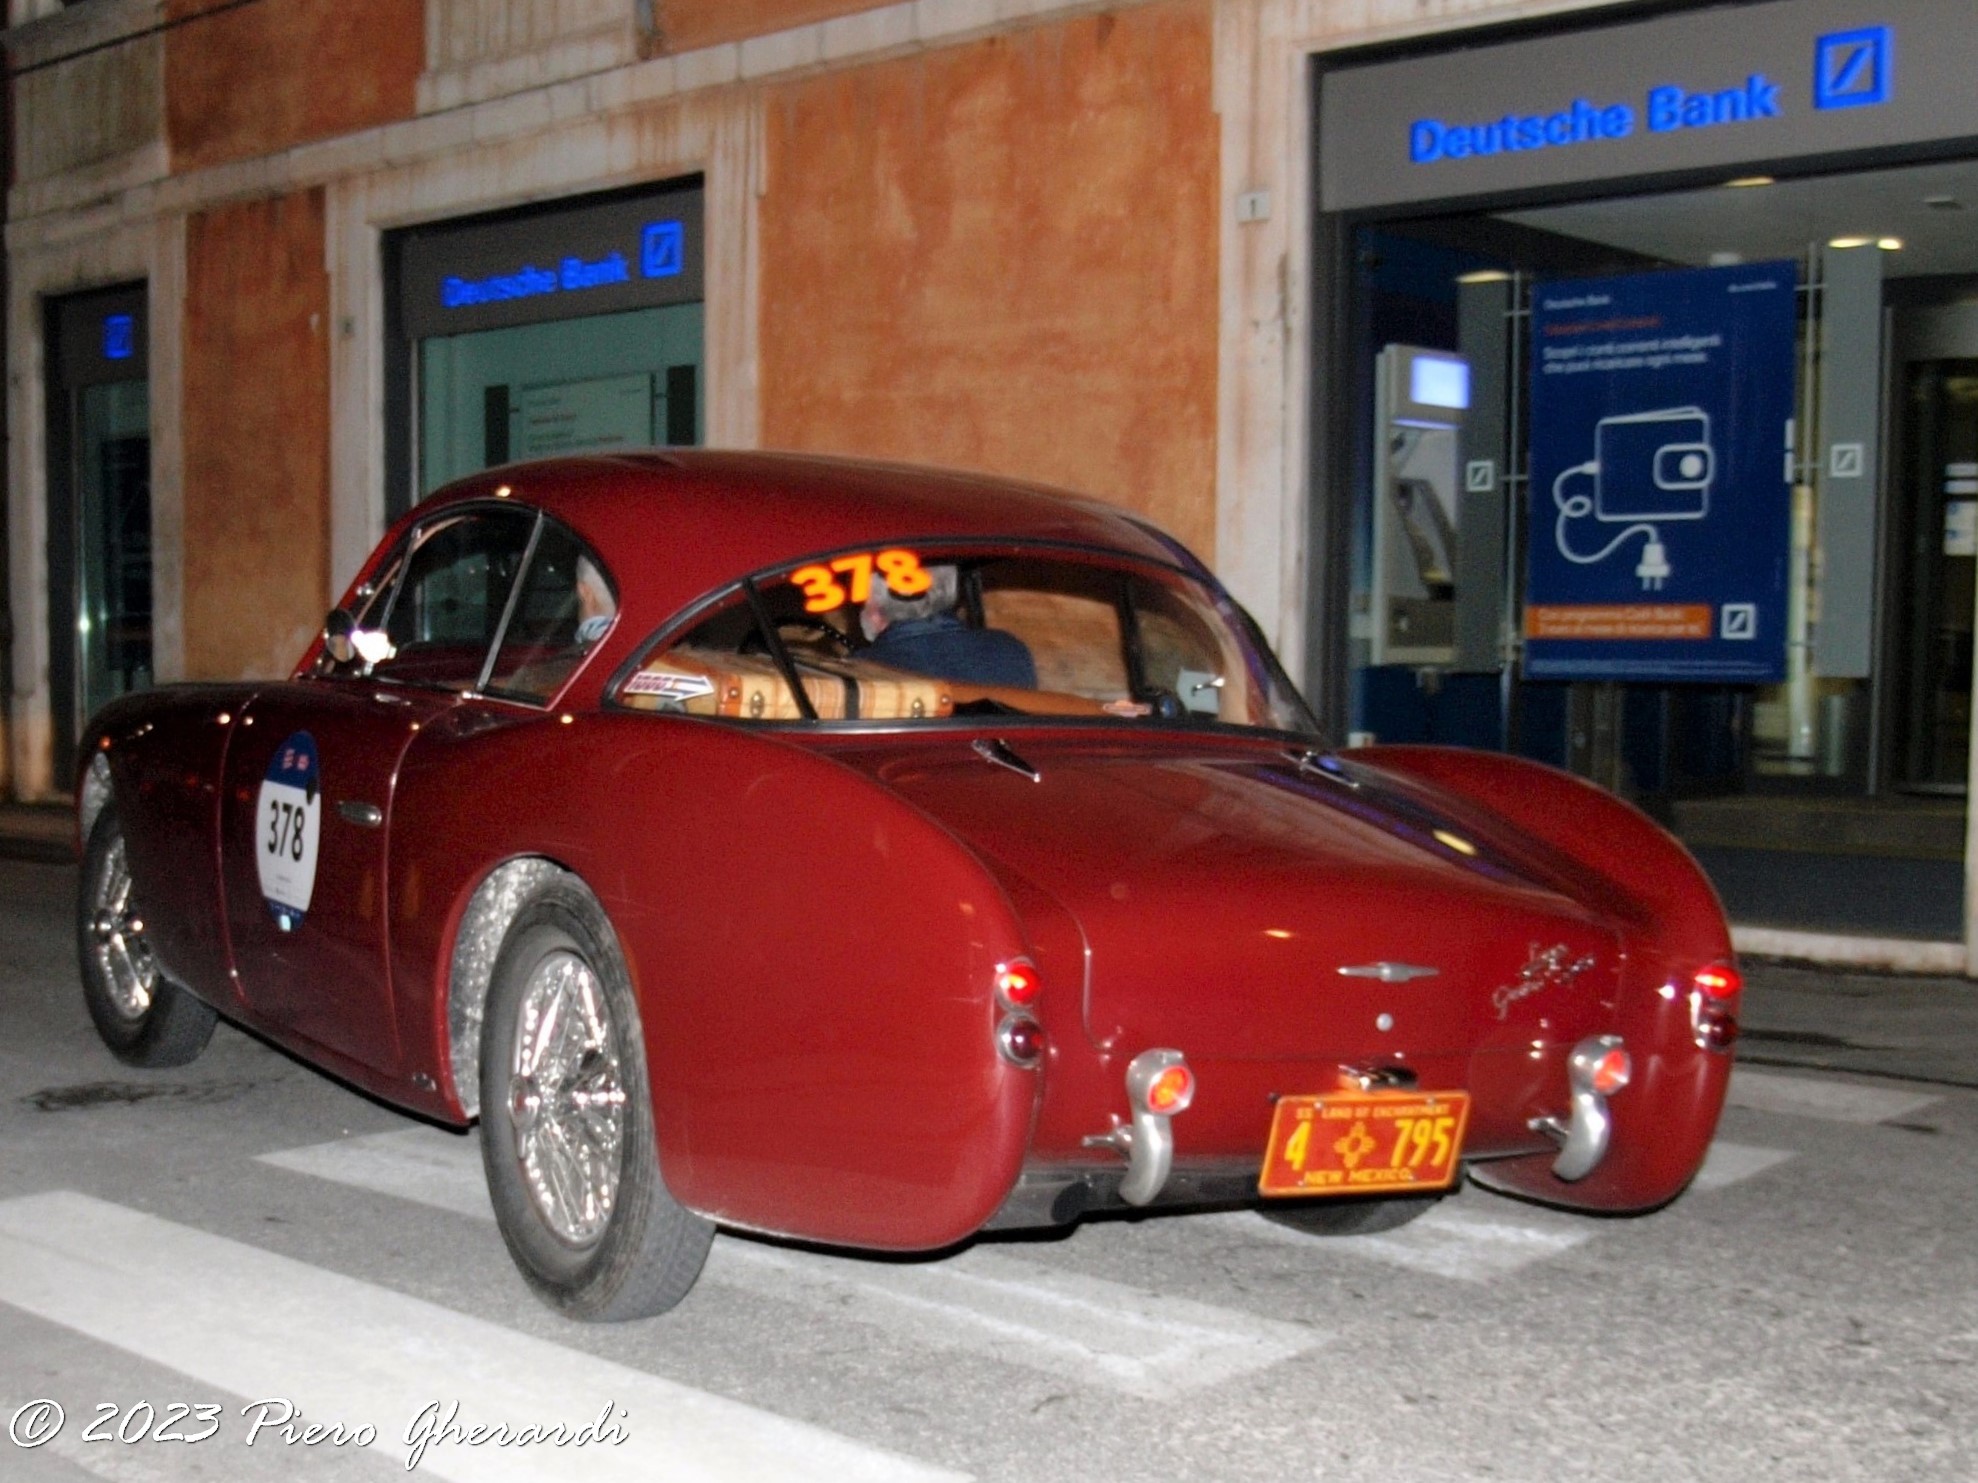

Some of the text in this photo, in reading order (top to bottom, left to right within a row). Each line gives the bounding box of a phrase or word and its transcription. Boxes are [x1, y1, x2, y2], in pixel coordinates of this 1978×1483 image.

[1410, 73, 1782, 163] Deutsche Bank
[560, 252, 629, 291] Bank
[790, 546, 933, 615] 378
[268, 799, 305, 862] 378
[1284, 1117, 1455, 1171] 4 795
[1304, 1167, 1414, 1185] NEW MEXICO
